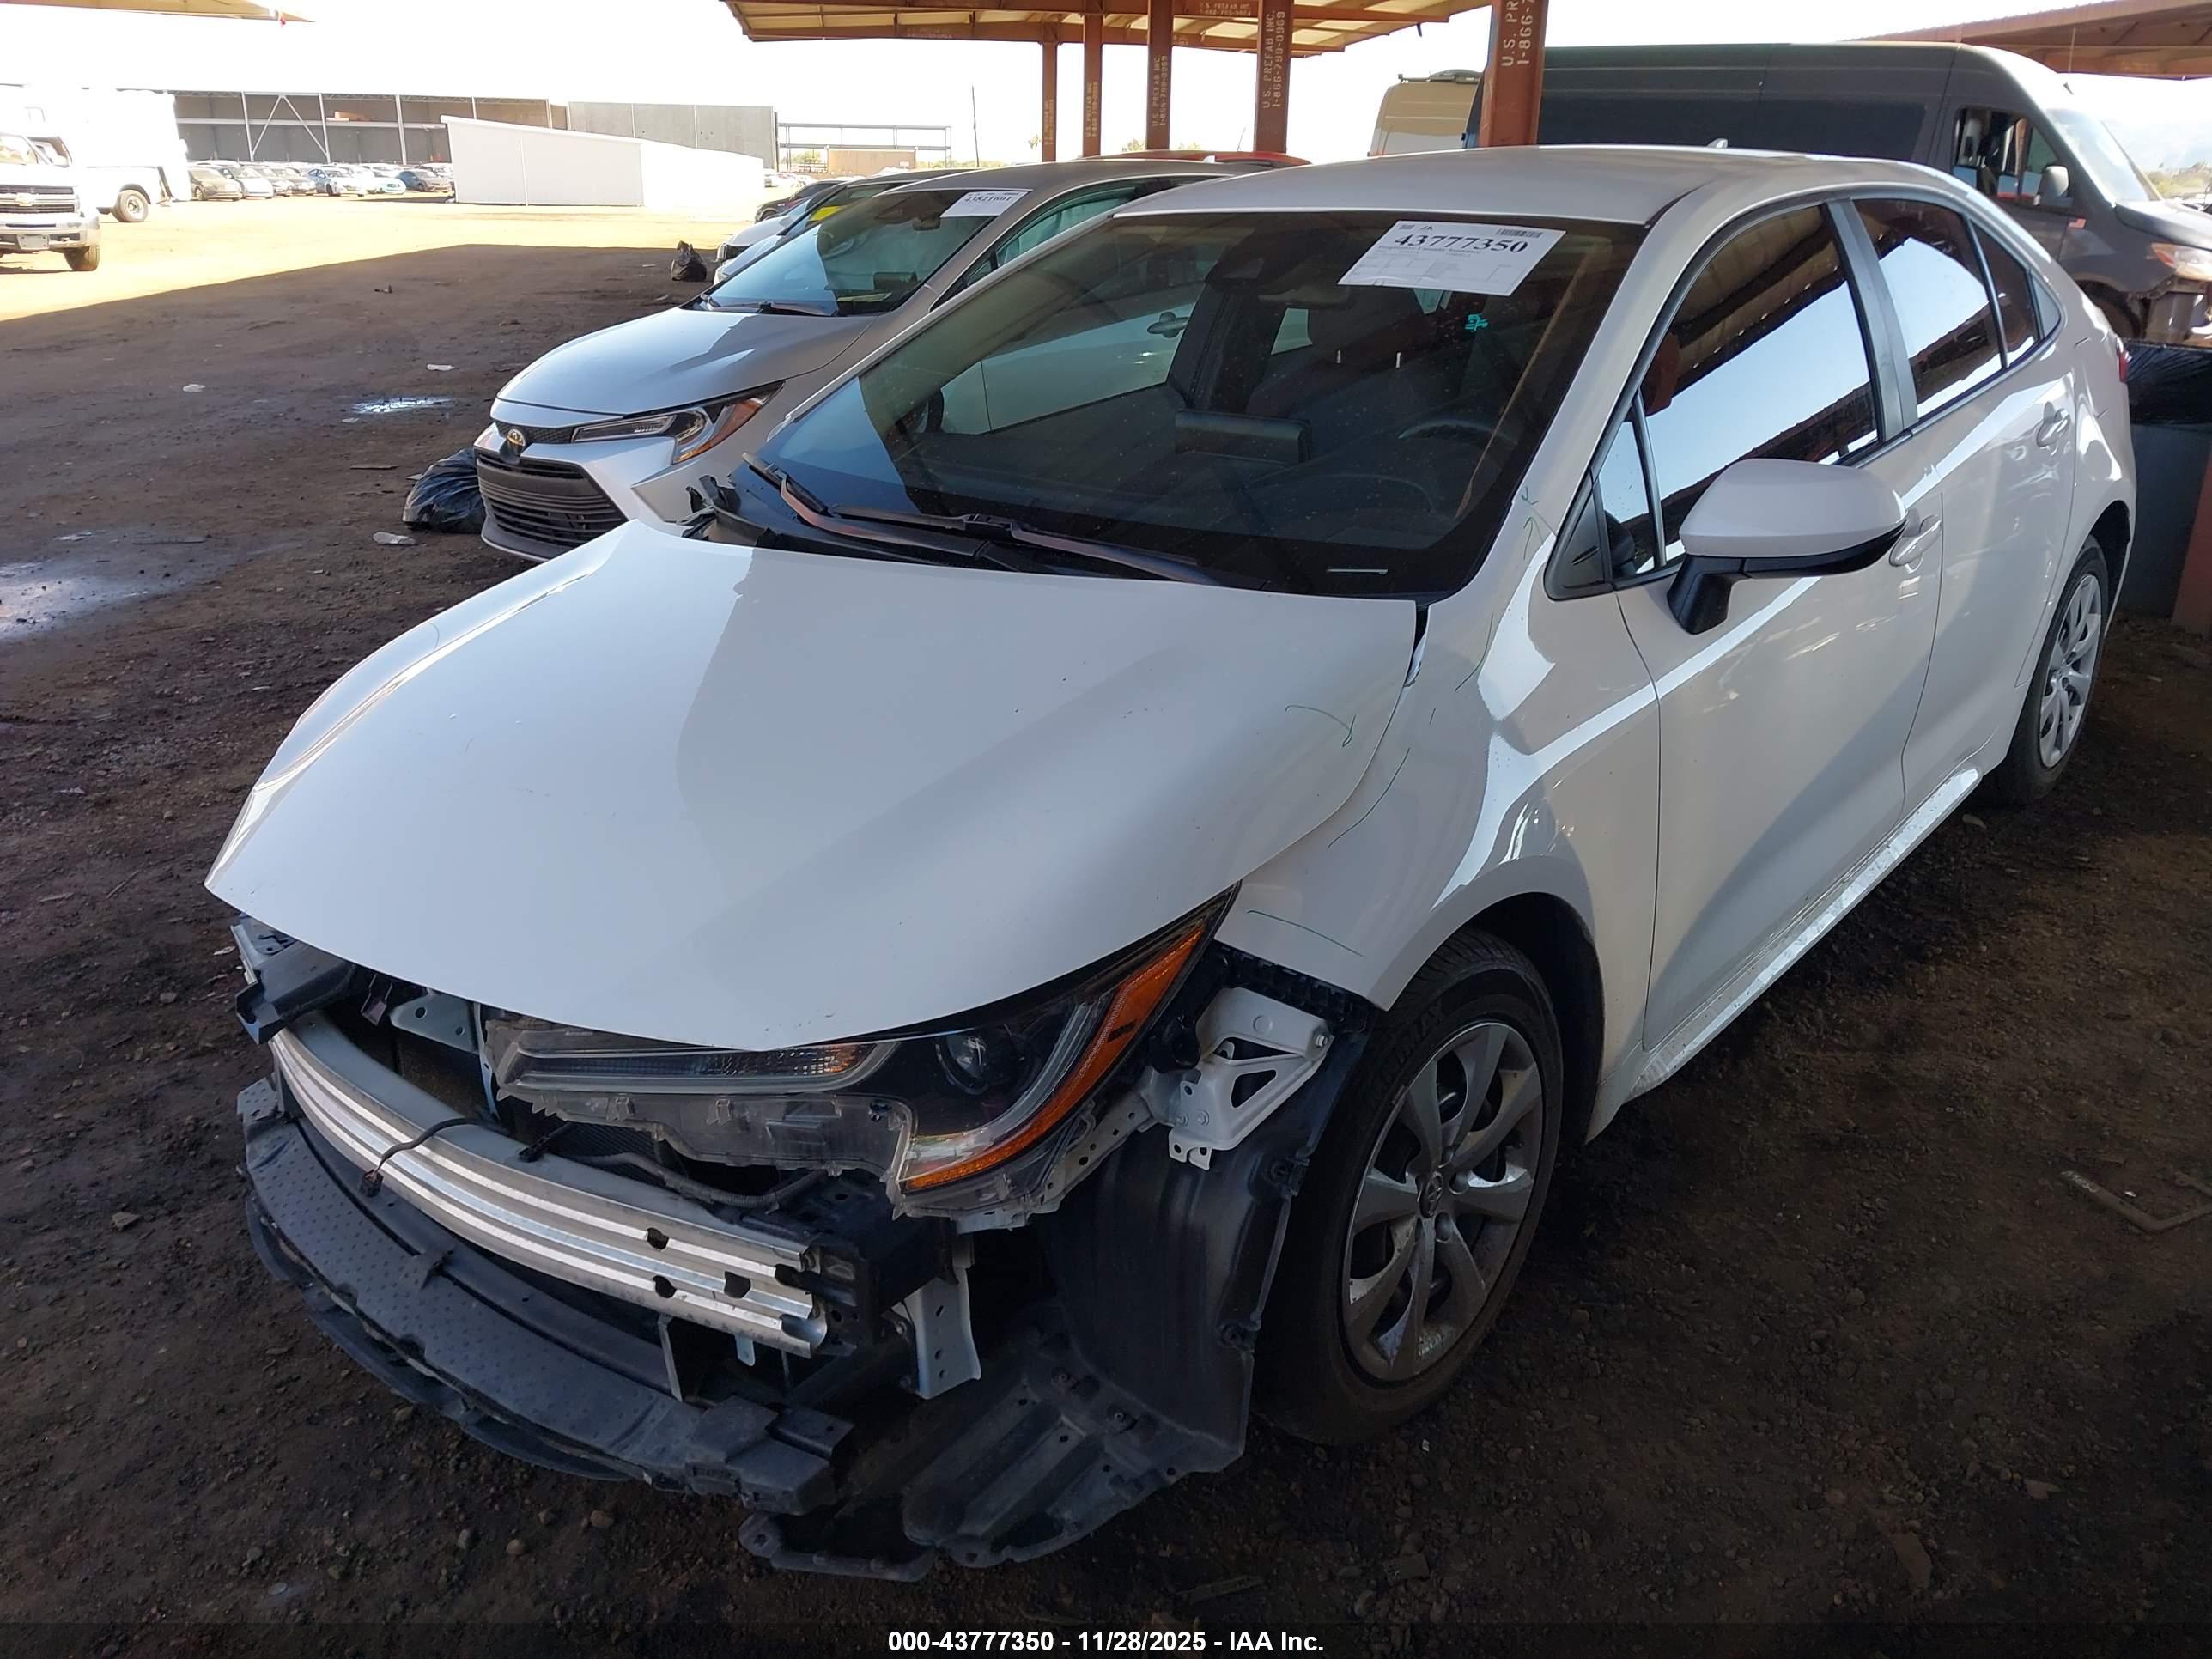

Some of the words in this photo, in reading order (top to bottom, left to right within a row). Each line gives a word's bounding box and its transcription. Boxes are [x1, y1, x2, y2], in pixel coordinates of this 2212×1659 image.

[1267, 10, 1275, 33] INC.
[1264, 38, 1273, 82] PREFAB
[1501, 33, 1516, 66] U.S.
[1262, 87, 1272, 108] U.S.
[1394, 234, 1528, 253] 43777350
